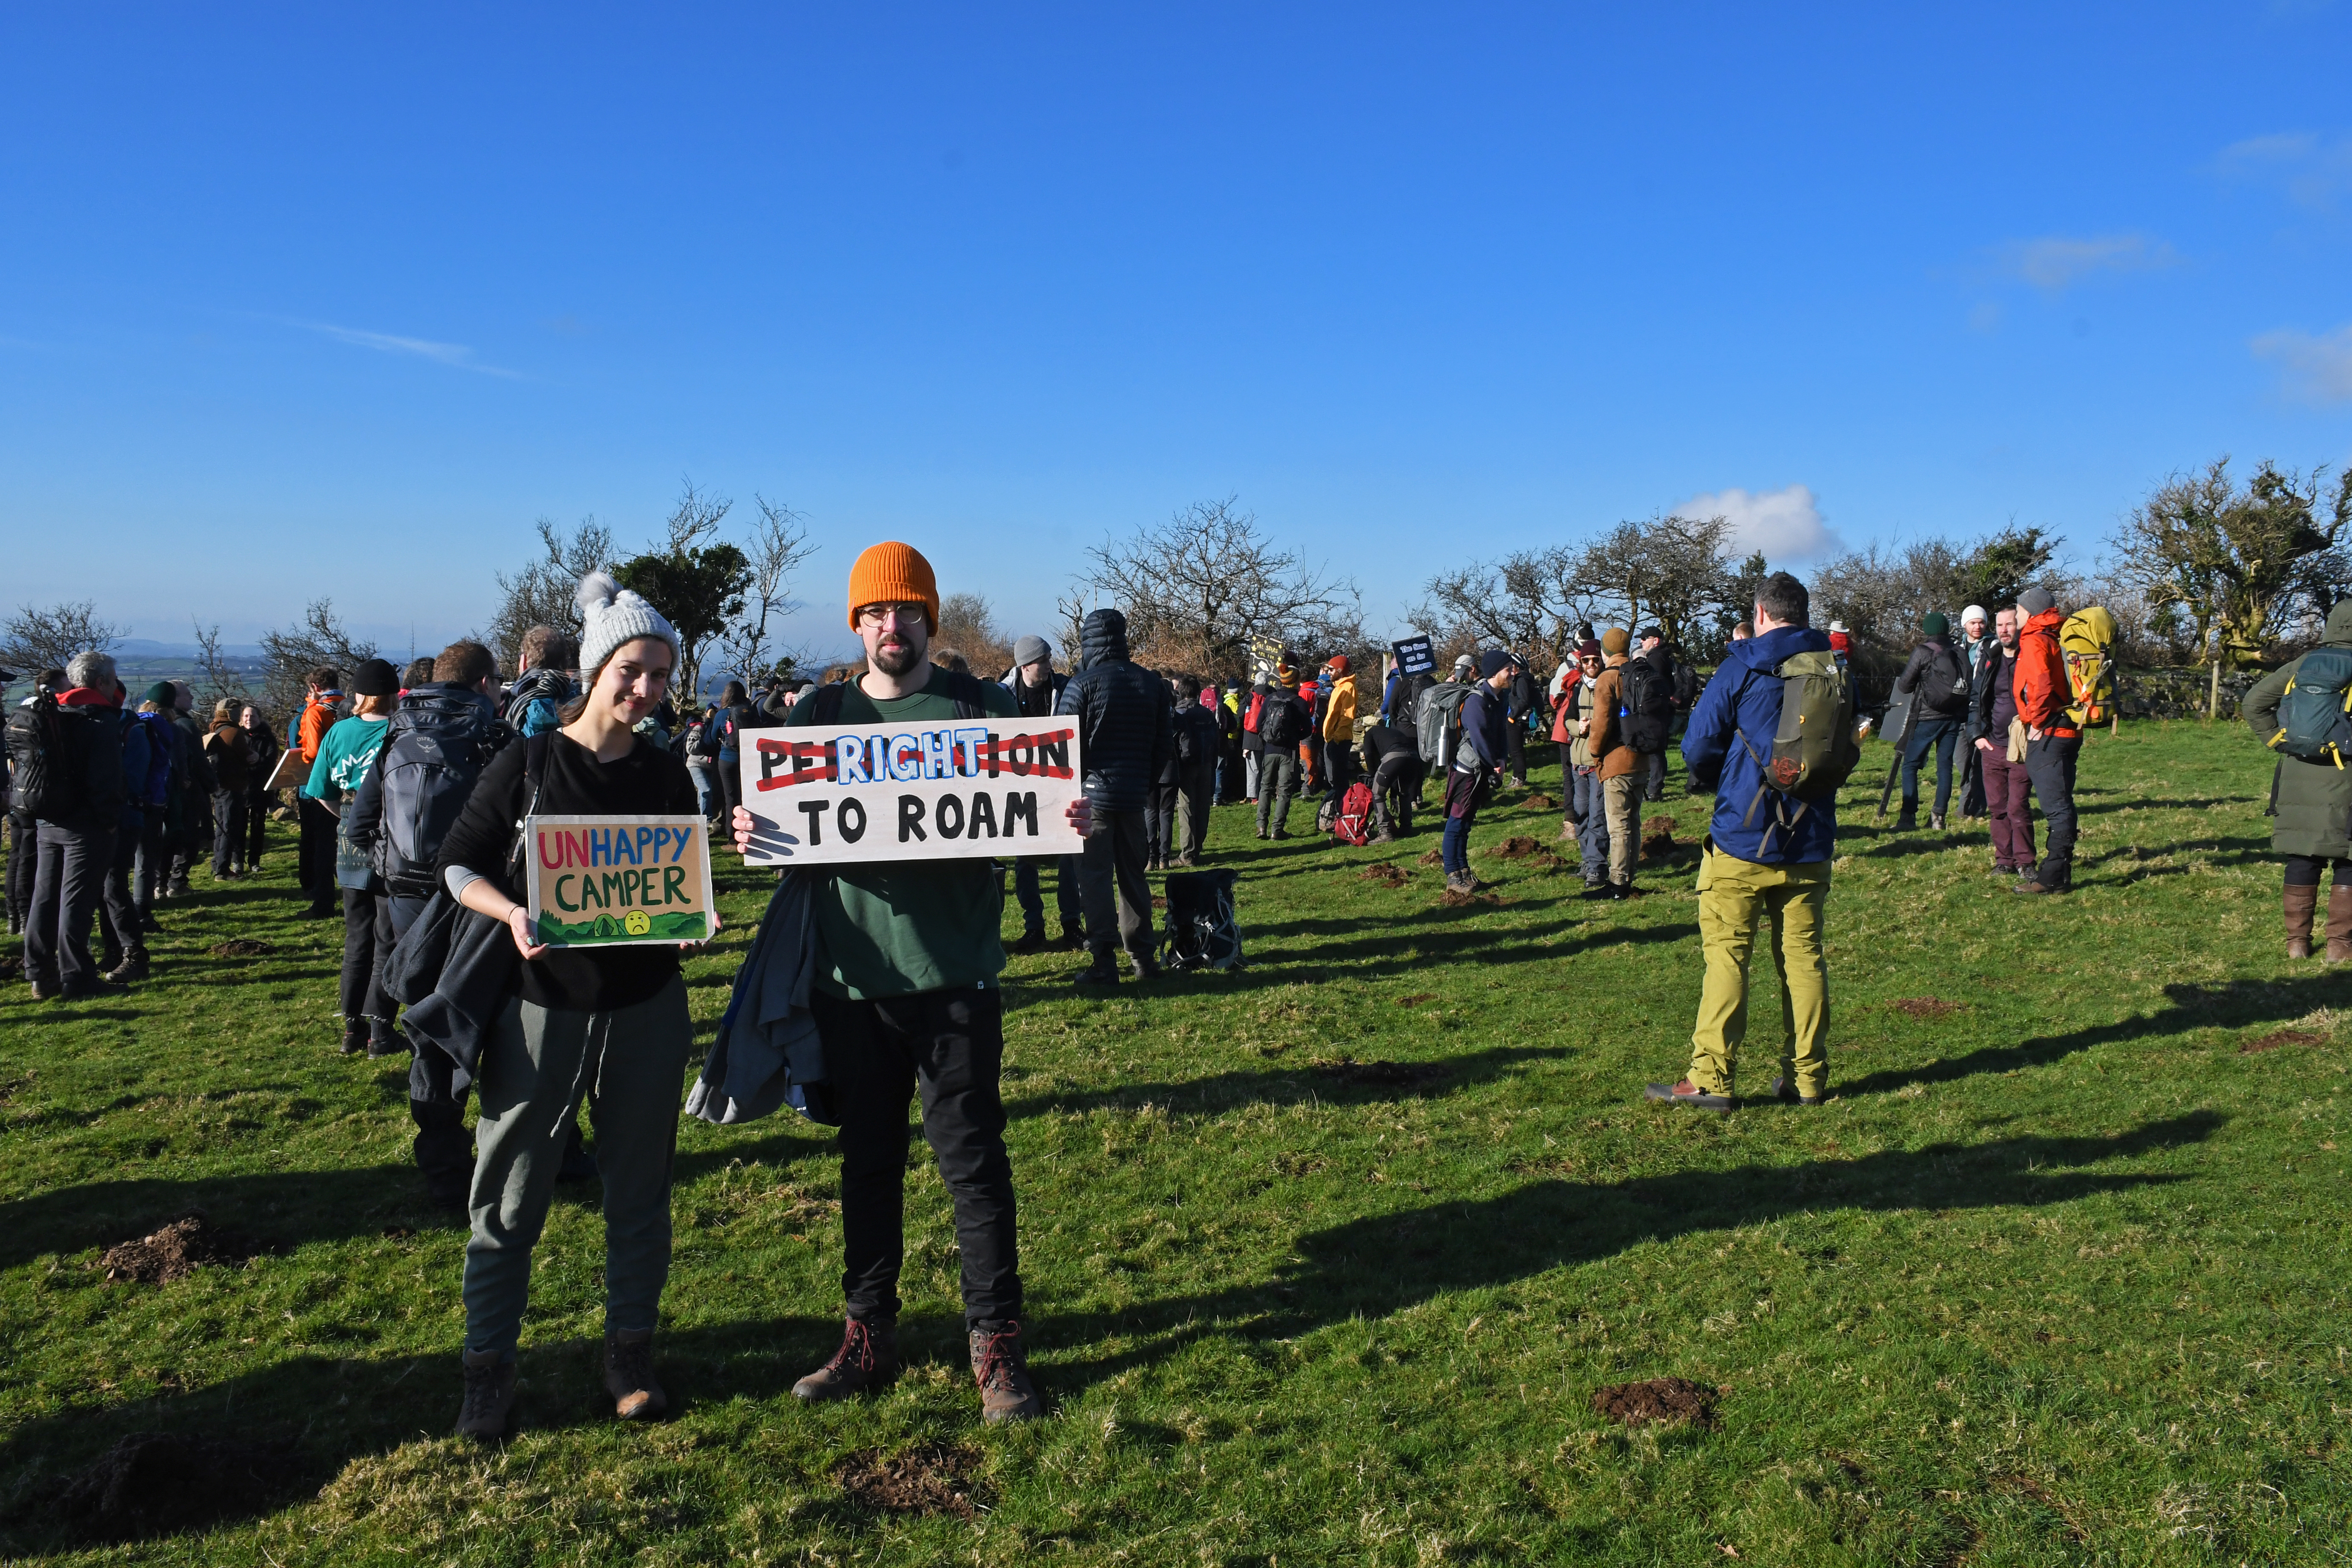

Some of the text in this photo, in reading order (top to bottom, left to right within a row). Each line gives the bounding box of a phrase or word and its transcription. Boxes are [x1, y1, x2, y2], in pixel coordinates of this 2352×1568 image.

[1256, 641, 1278, 653] THE STARS
[1406, 662, 1431, 672] Everyone
[836, 727, 988, 785] RIGHT
[798, 791, 1039, 846] TO ROAM
[538, 827, 692, 869] UNHAPPY
[555, 866, 691, 912] CAMPER
